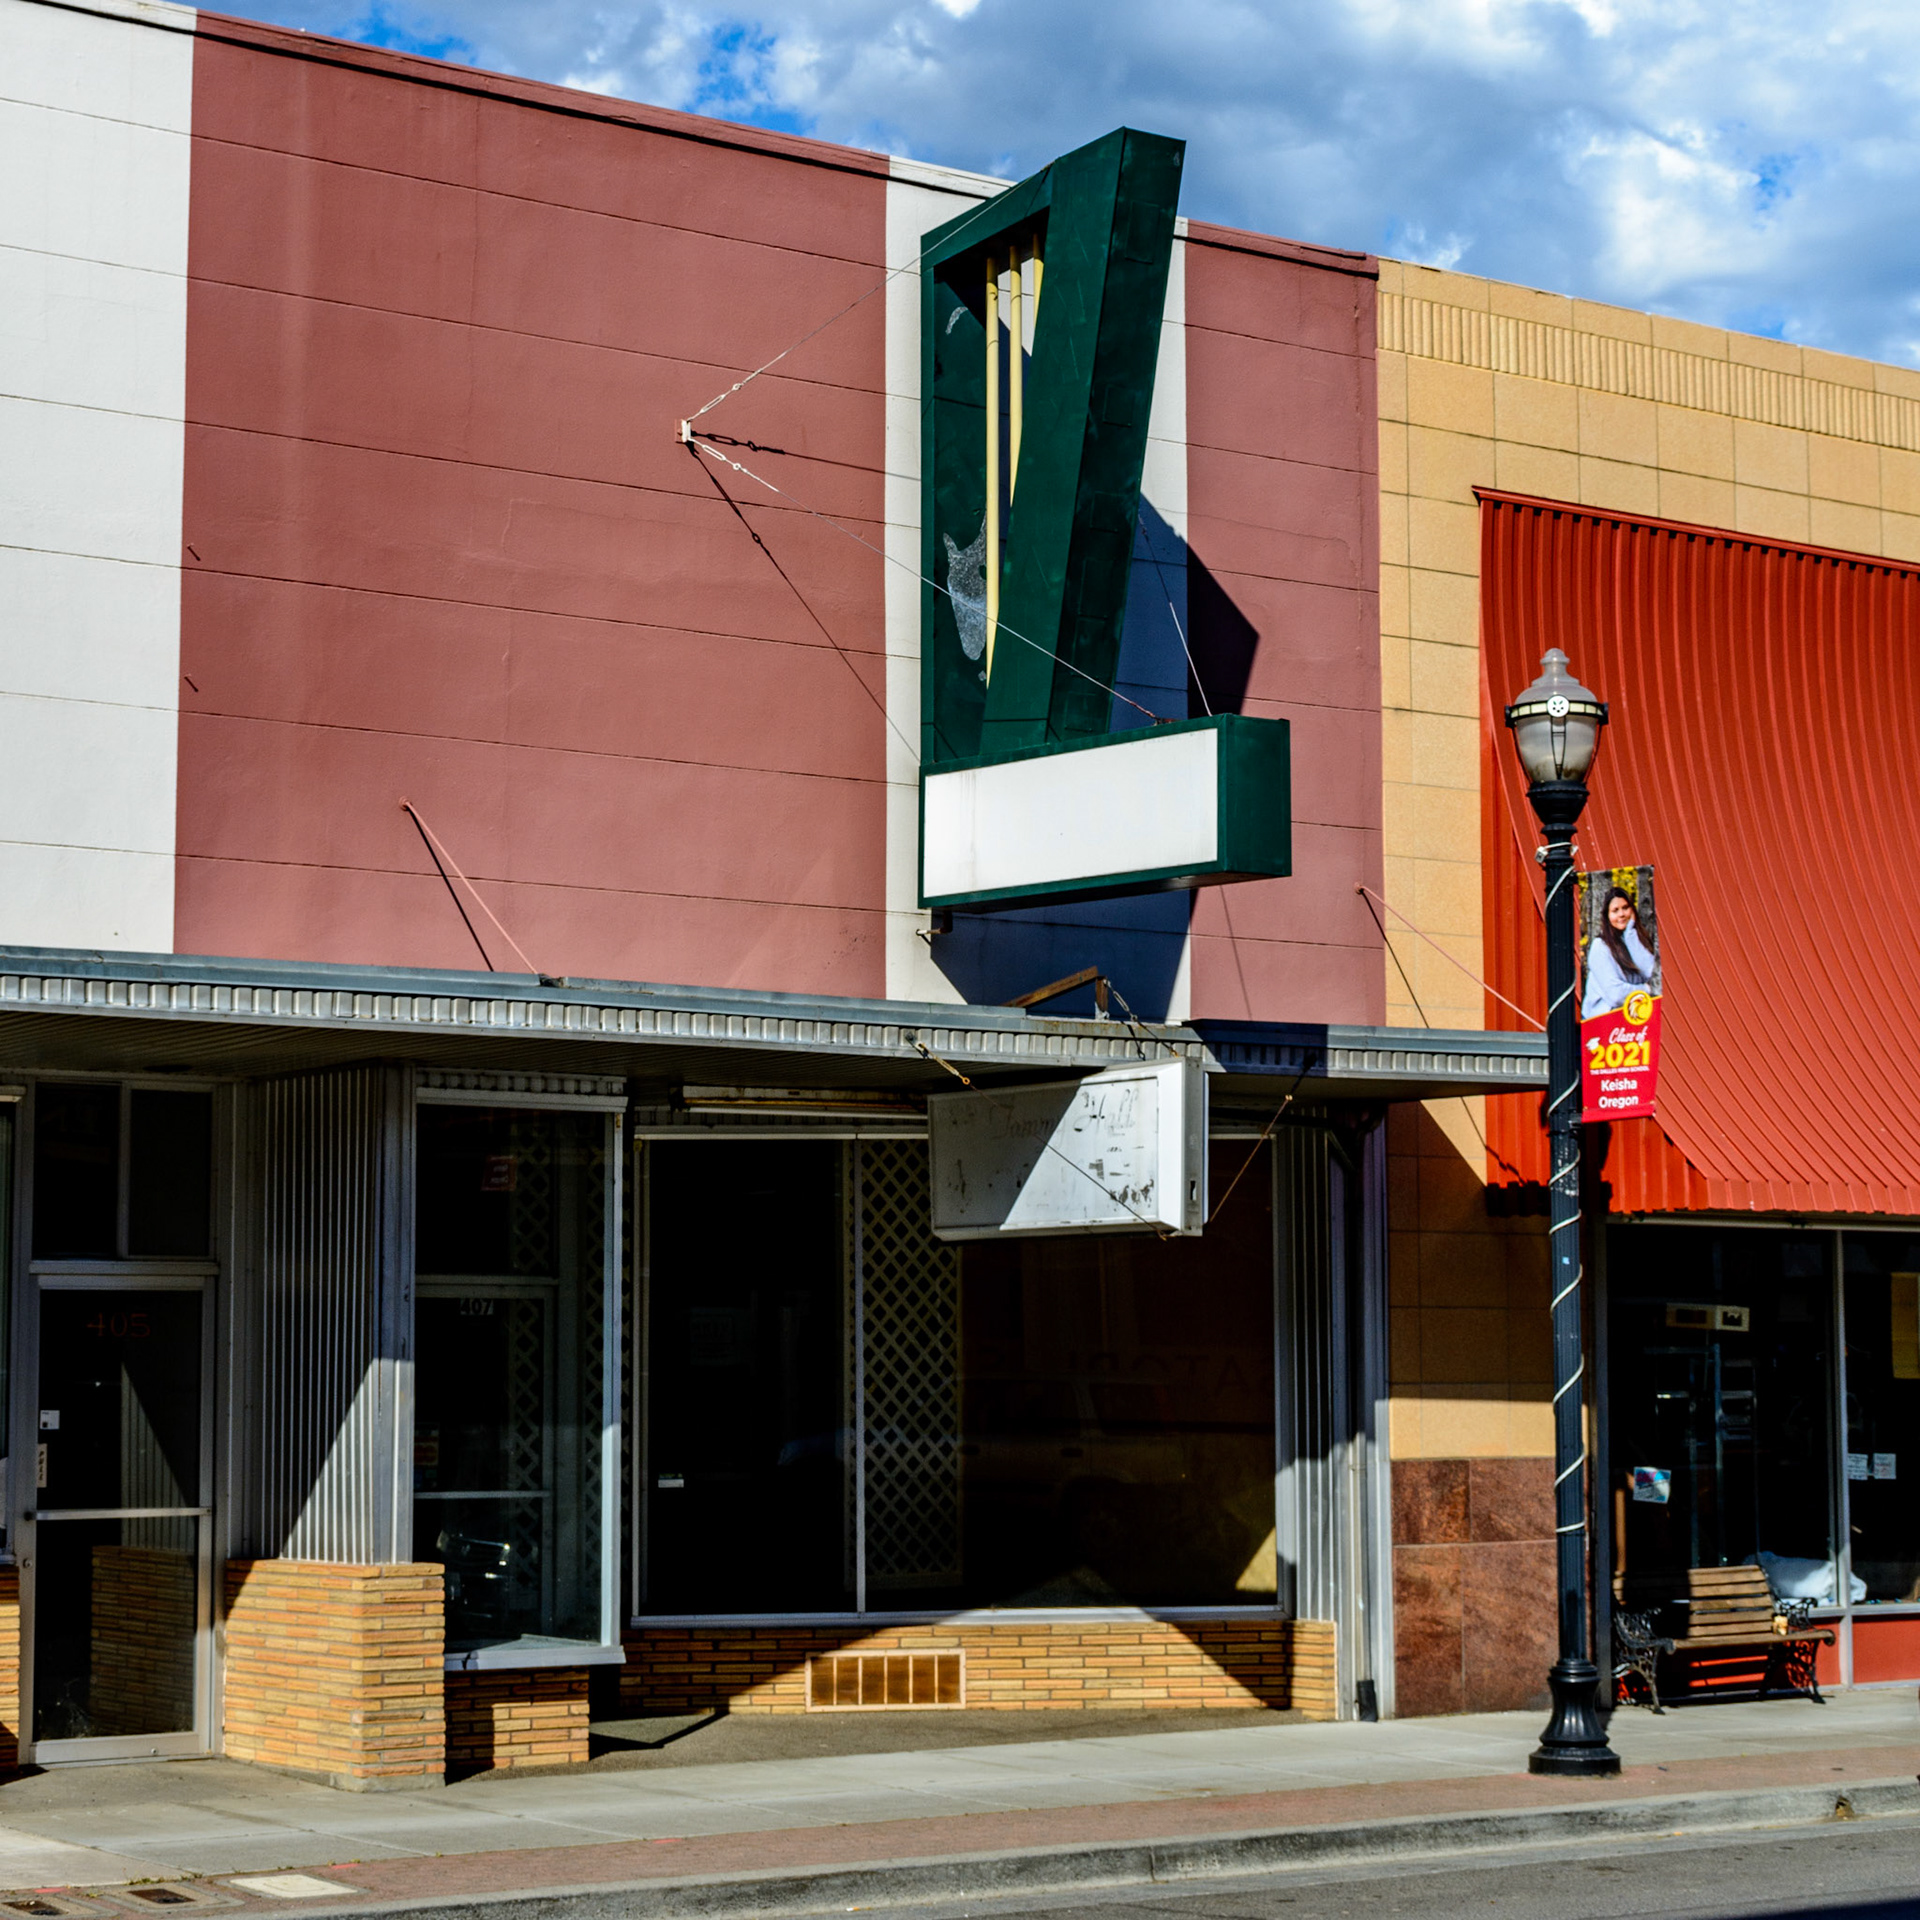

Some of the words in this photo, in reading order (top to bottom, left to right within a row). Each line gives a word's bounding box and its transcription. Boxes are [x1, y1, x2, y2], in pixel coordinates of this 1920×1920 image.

[1609, 1027, 1635, 1044] Class
[1635, 1026, 1648, 1046] of
[1590, 1041, 1650, 1069] 2021
[1601, 1078, 1637, 1092] Keisha
[1598, 1096, 1639, 1108] Oregon
[460, 1298, 491, 1314] 407
[85, 1311, 152, 1338] 405
